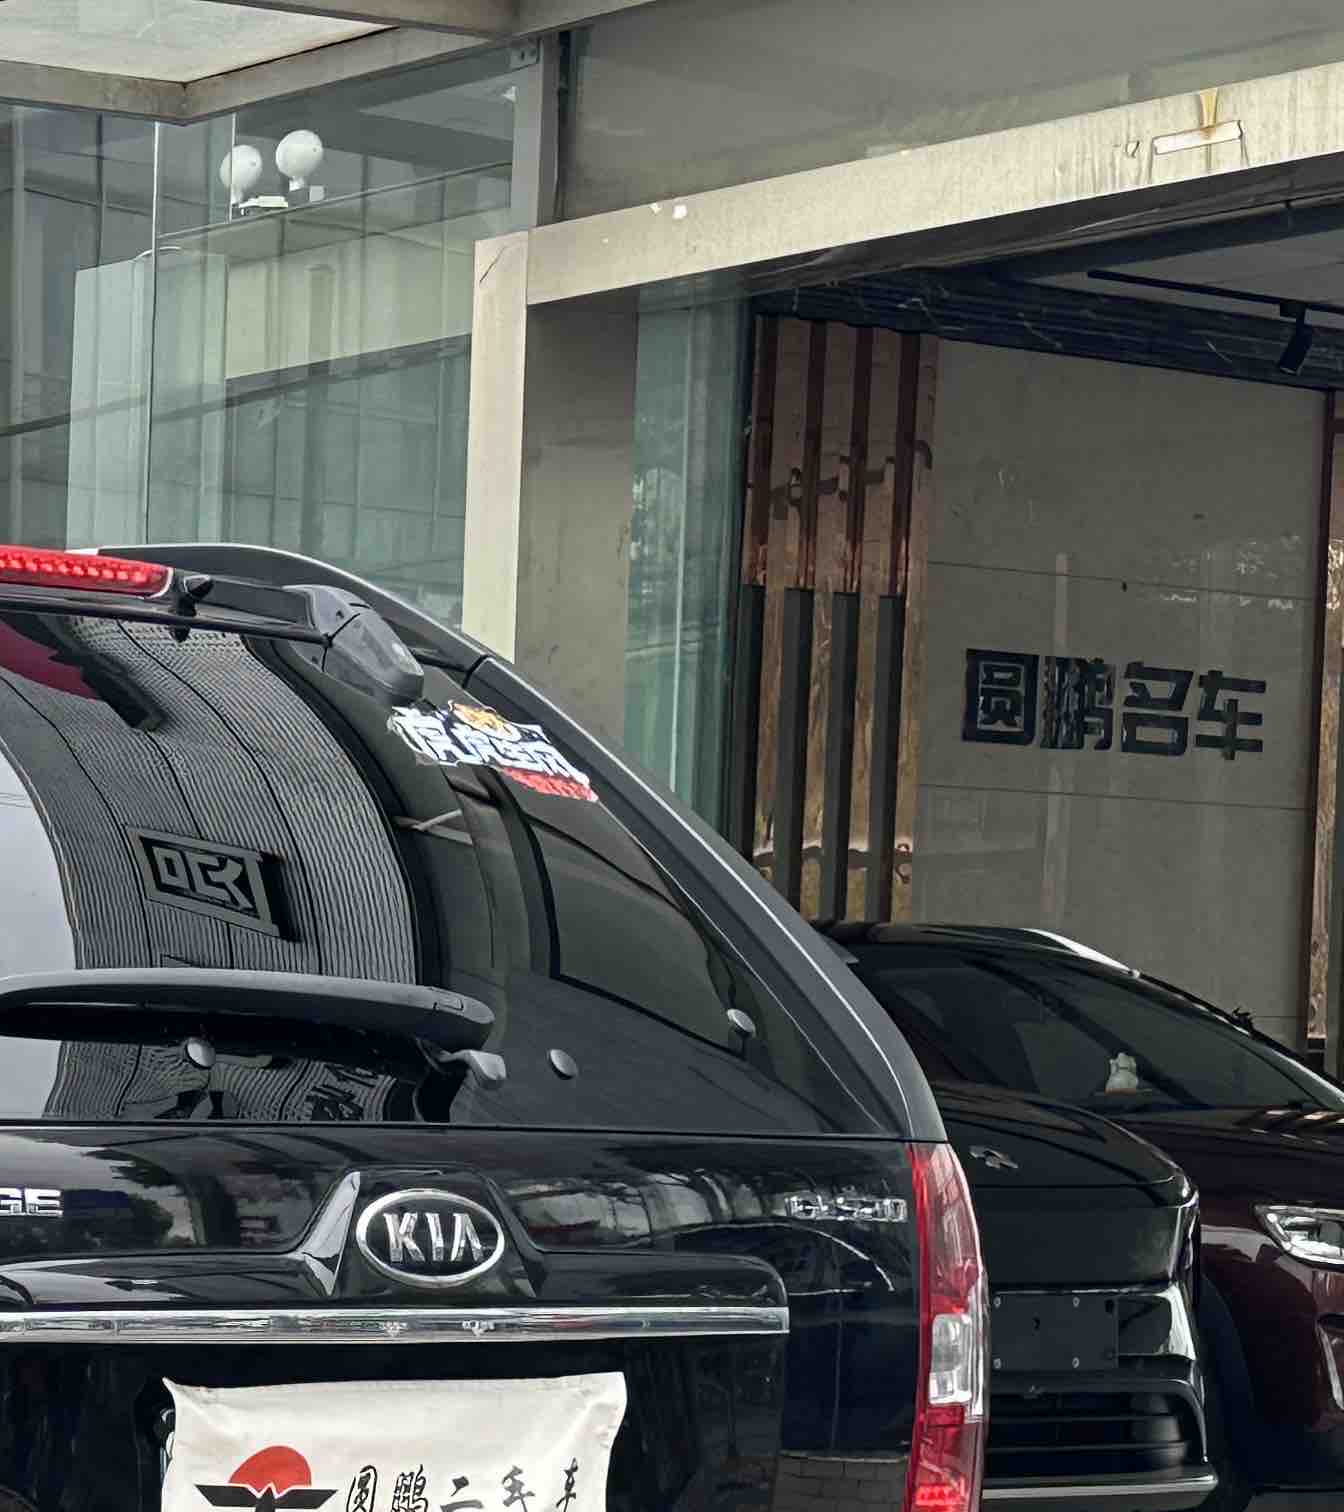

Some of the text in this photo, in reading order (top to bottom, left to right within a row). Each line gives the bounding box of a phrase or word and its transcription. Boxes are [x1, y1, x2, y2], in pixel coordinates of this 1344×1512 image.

[961, 647, 1267, 761] 圆鹏名车
[383, 1211, 485, 1263] KIA
